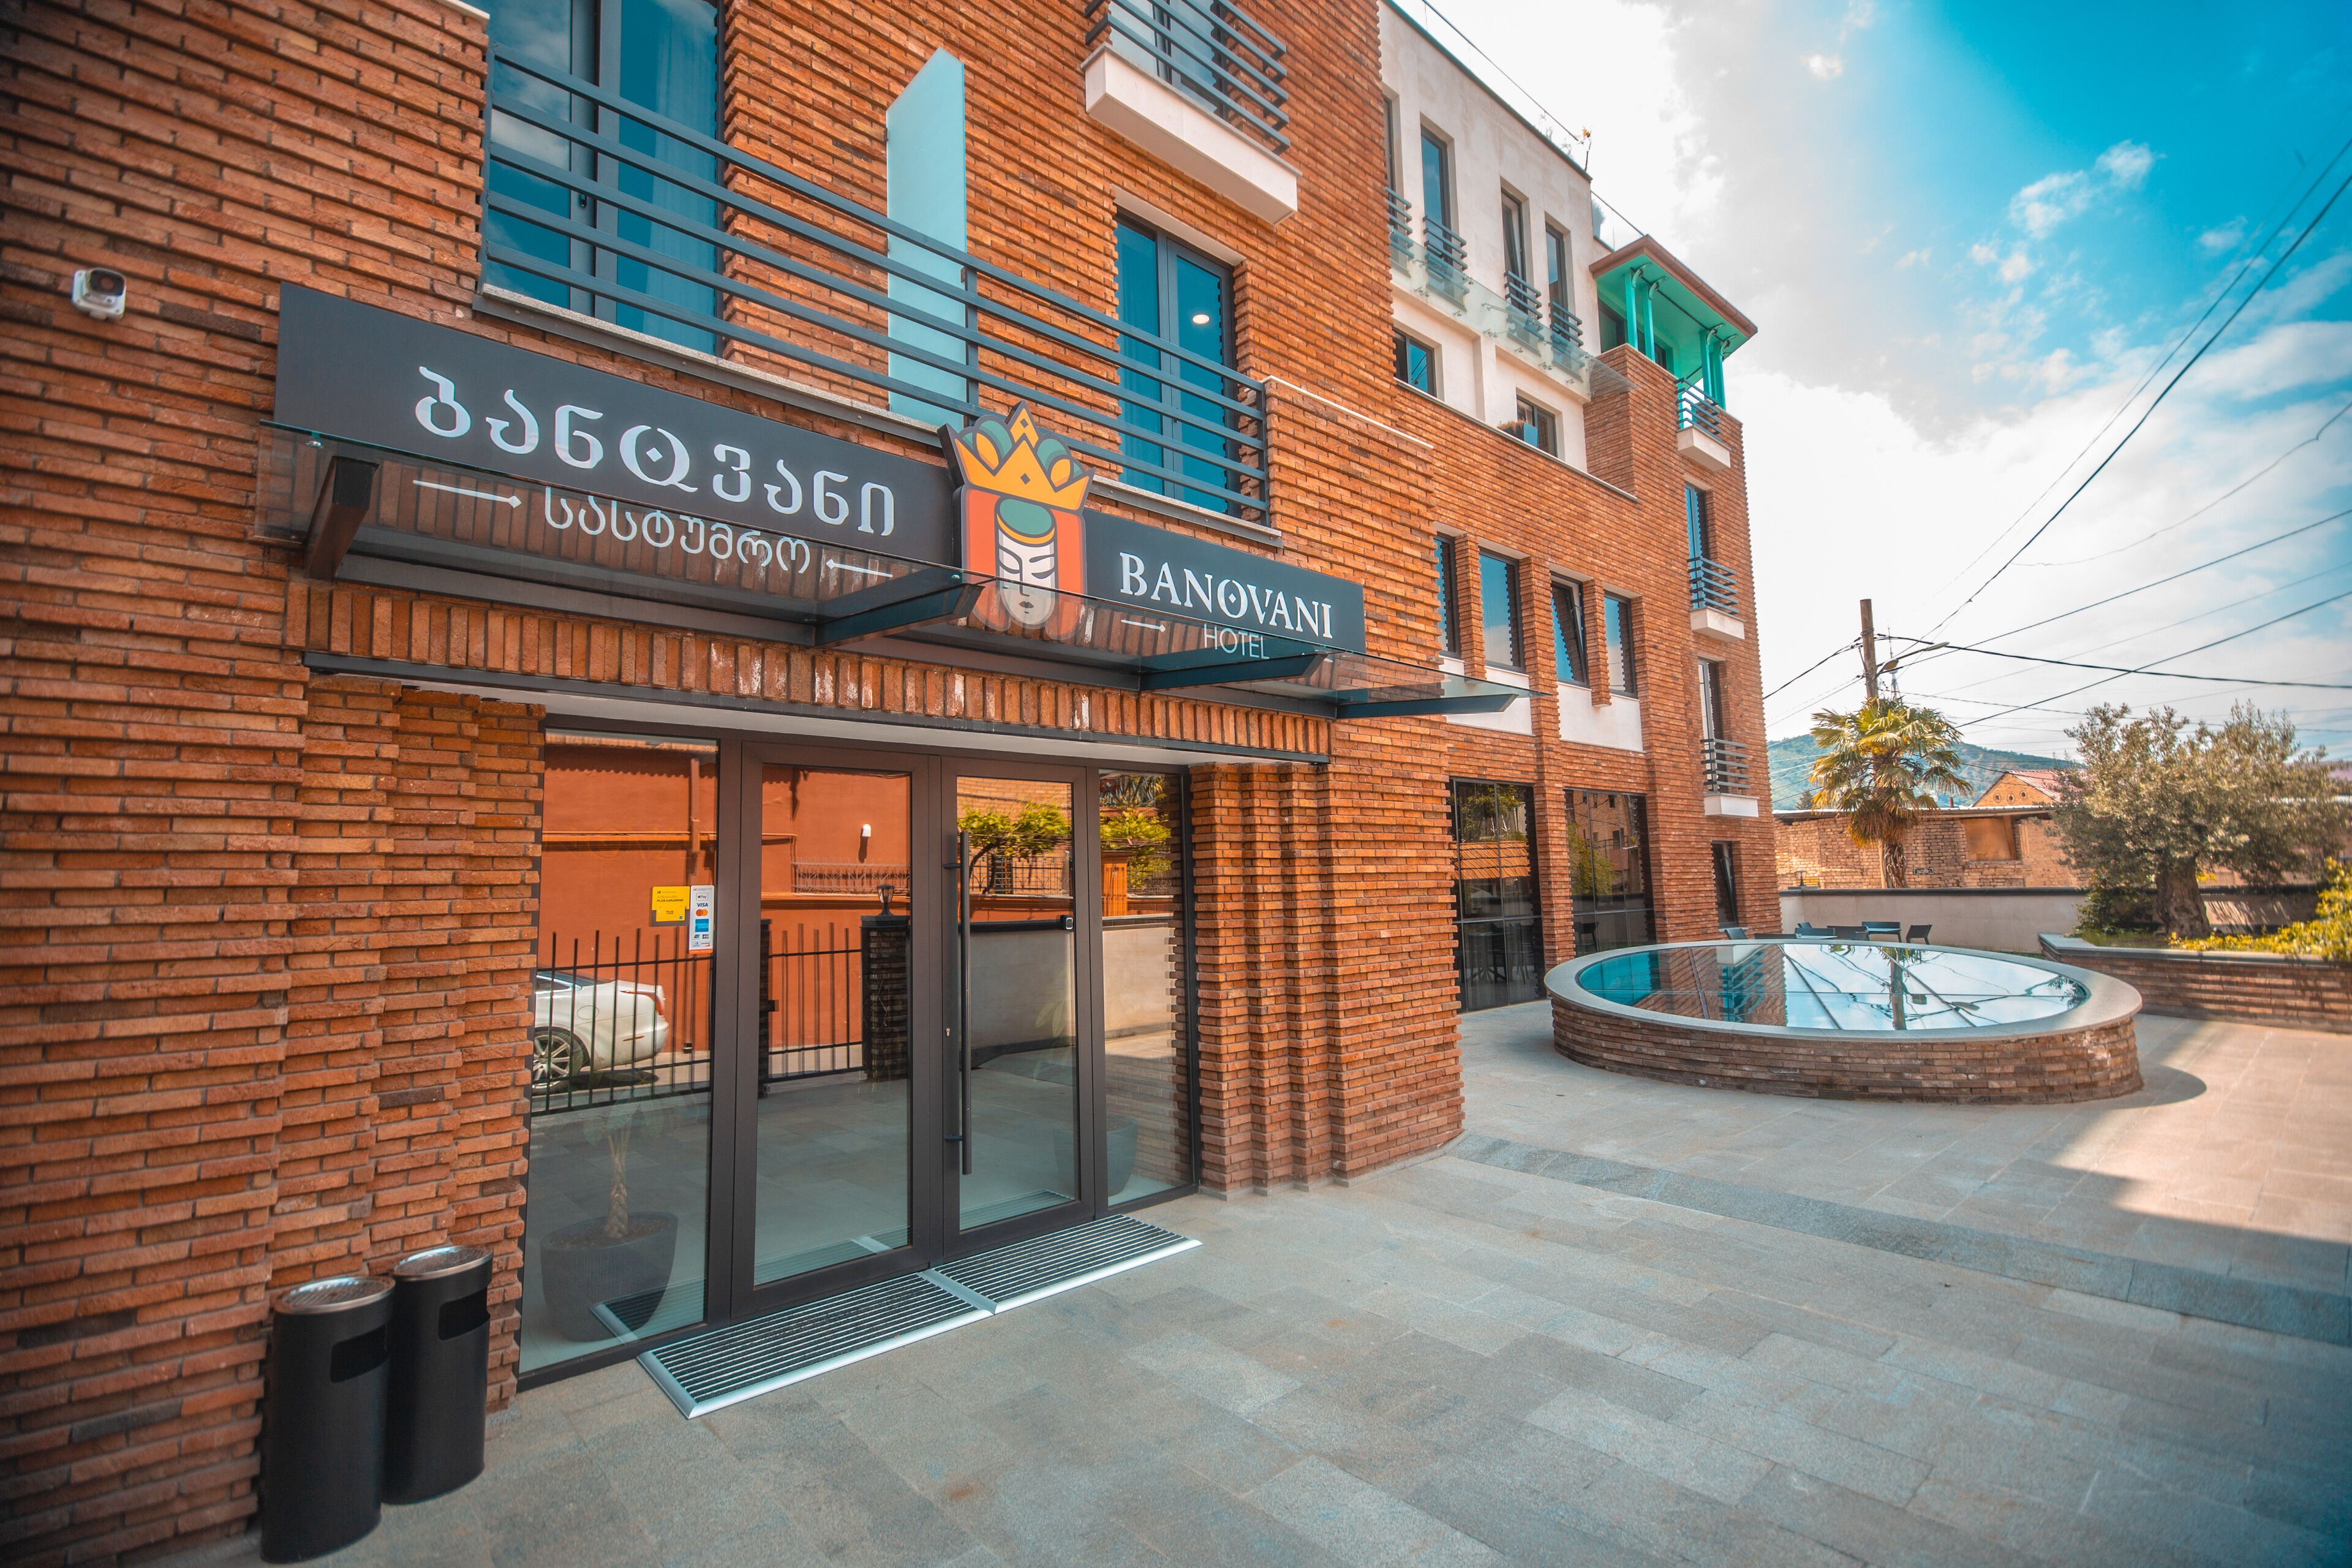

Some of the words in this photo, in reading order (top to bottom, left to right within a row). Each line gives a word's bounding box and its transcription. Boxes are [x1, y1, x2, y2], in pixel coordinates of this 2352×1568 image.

[545, 486, 810, 573] სასტუმრო
[1119, 552, 1333, 639] BANOVANI
[1204, 624, 1270, 660] HOTEL
